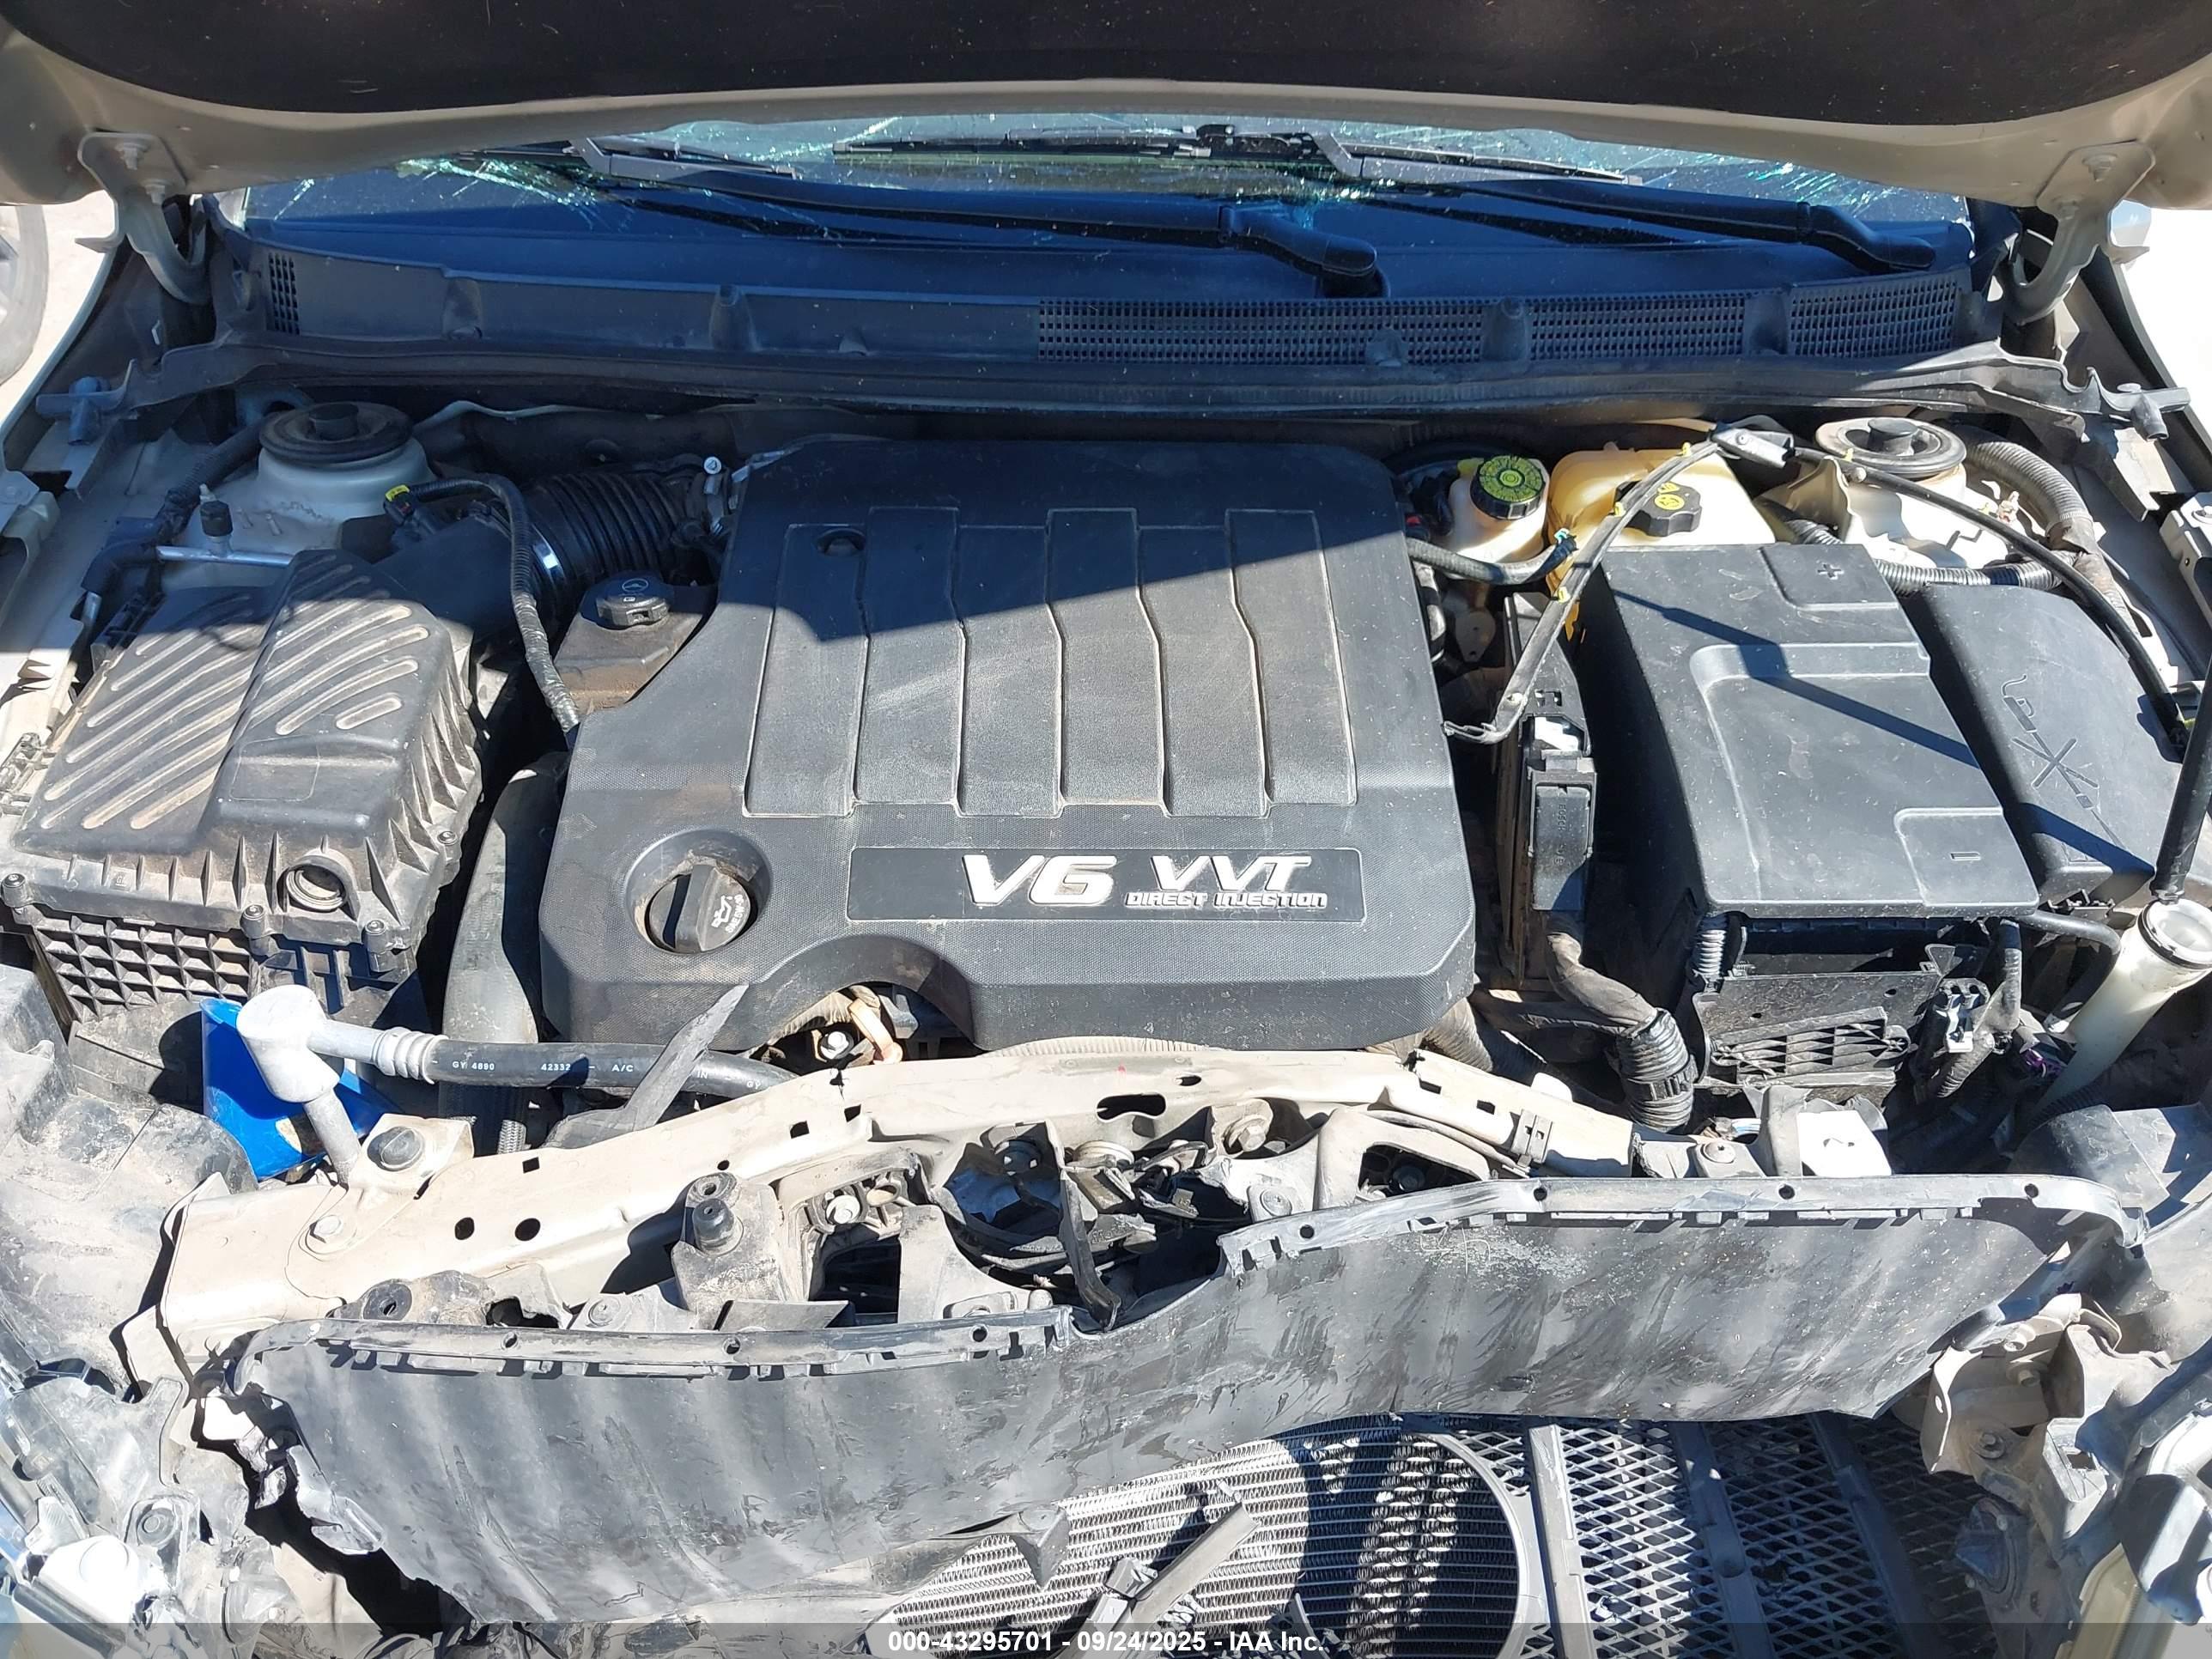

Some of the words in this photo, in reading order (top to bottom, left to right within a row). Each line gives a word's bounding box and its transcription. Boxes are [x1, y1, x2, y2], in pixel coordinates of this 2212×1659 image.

[962, 854, 1117, 907] V6
[1151, 855, 1312, 891] VVT
[1125, 892, 1207, 908] DIRECT
[1212, 892, 1328, 908] INJECTION
[452, 1060, 466, 1069] GY
[611, 1064, 634, 1073] A/C
